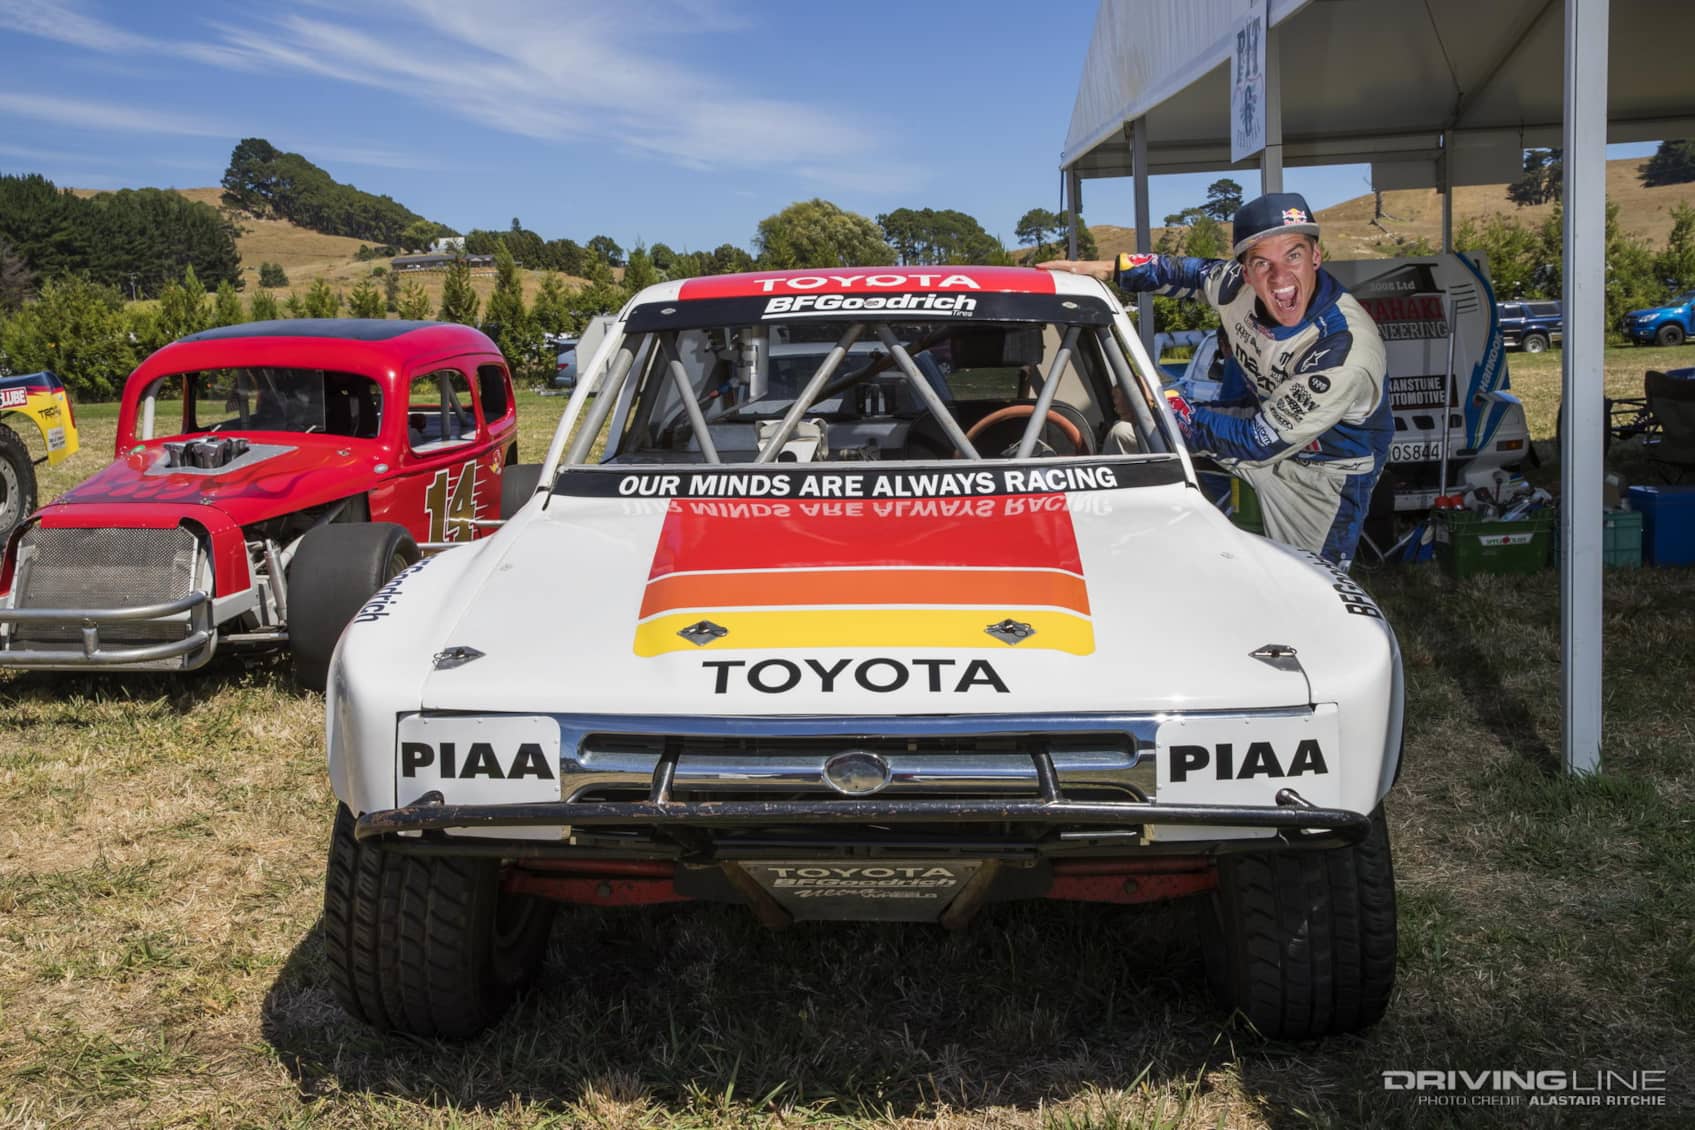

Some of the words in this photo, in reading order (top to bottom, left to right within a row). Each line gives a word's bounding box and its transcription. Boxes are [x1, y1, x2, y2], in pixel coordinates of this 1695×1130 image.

[753, 274, 981, 292] TOYOTA
[764, 293, 977, 314] BFGoodrich
[1378, 321, 1449, 339] NEERING
[1392, 444, 1440, 461] OS844
[618, 475, 680, 496] OUR
[688, 474, 791, 497] MINDS
[799, 474, 865, 497] ARE
[872, 471, 997, 497] ALWAYS
[1004, 466, 1118, 492] RACING
[424, 459, 478, 545] 14
[702, 657, 1011, 694] TOYOTA
[402, 740, 555, 780] PIAA
[1168, 738, 1329, 783] PIAA
[768, 867, 955, 878] TOYOTA
[773, 878, 957, 888] BFGoodrich
